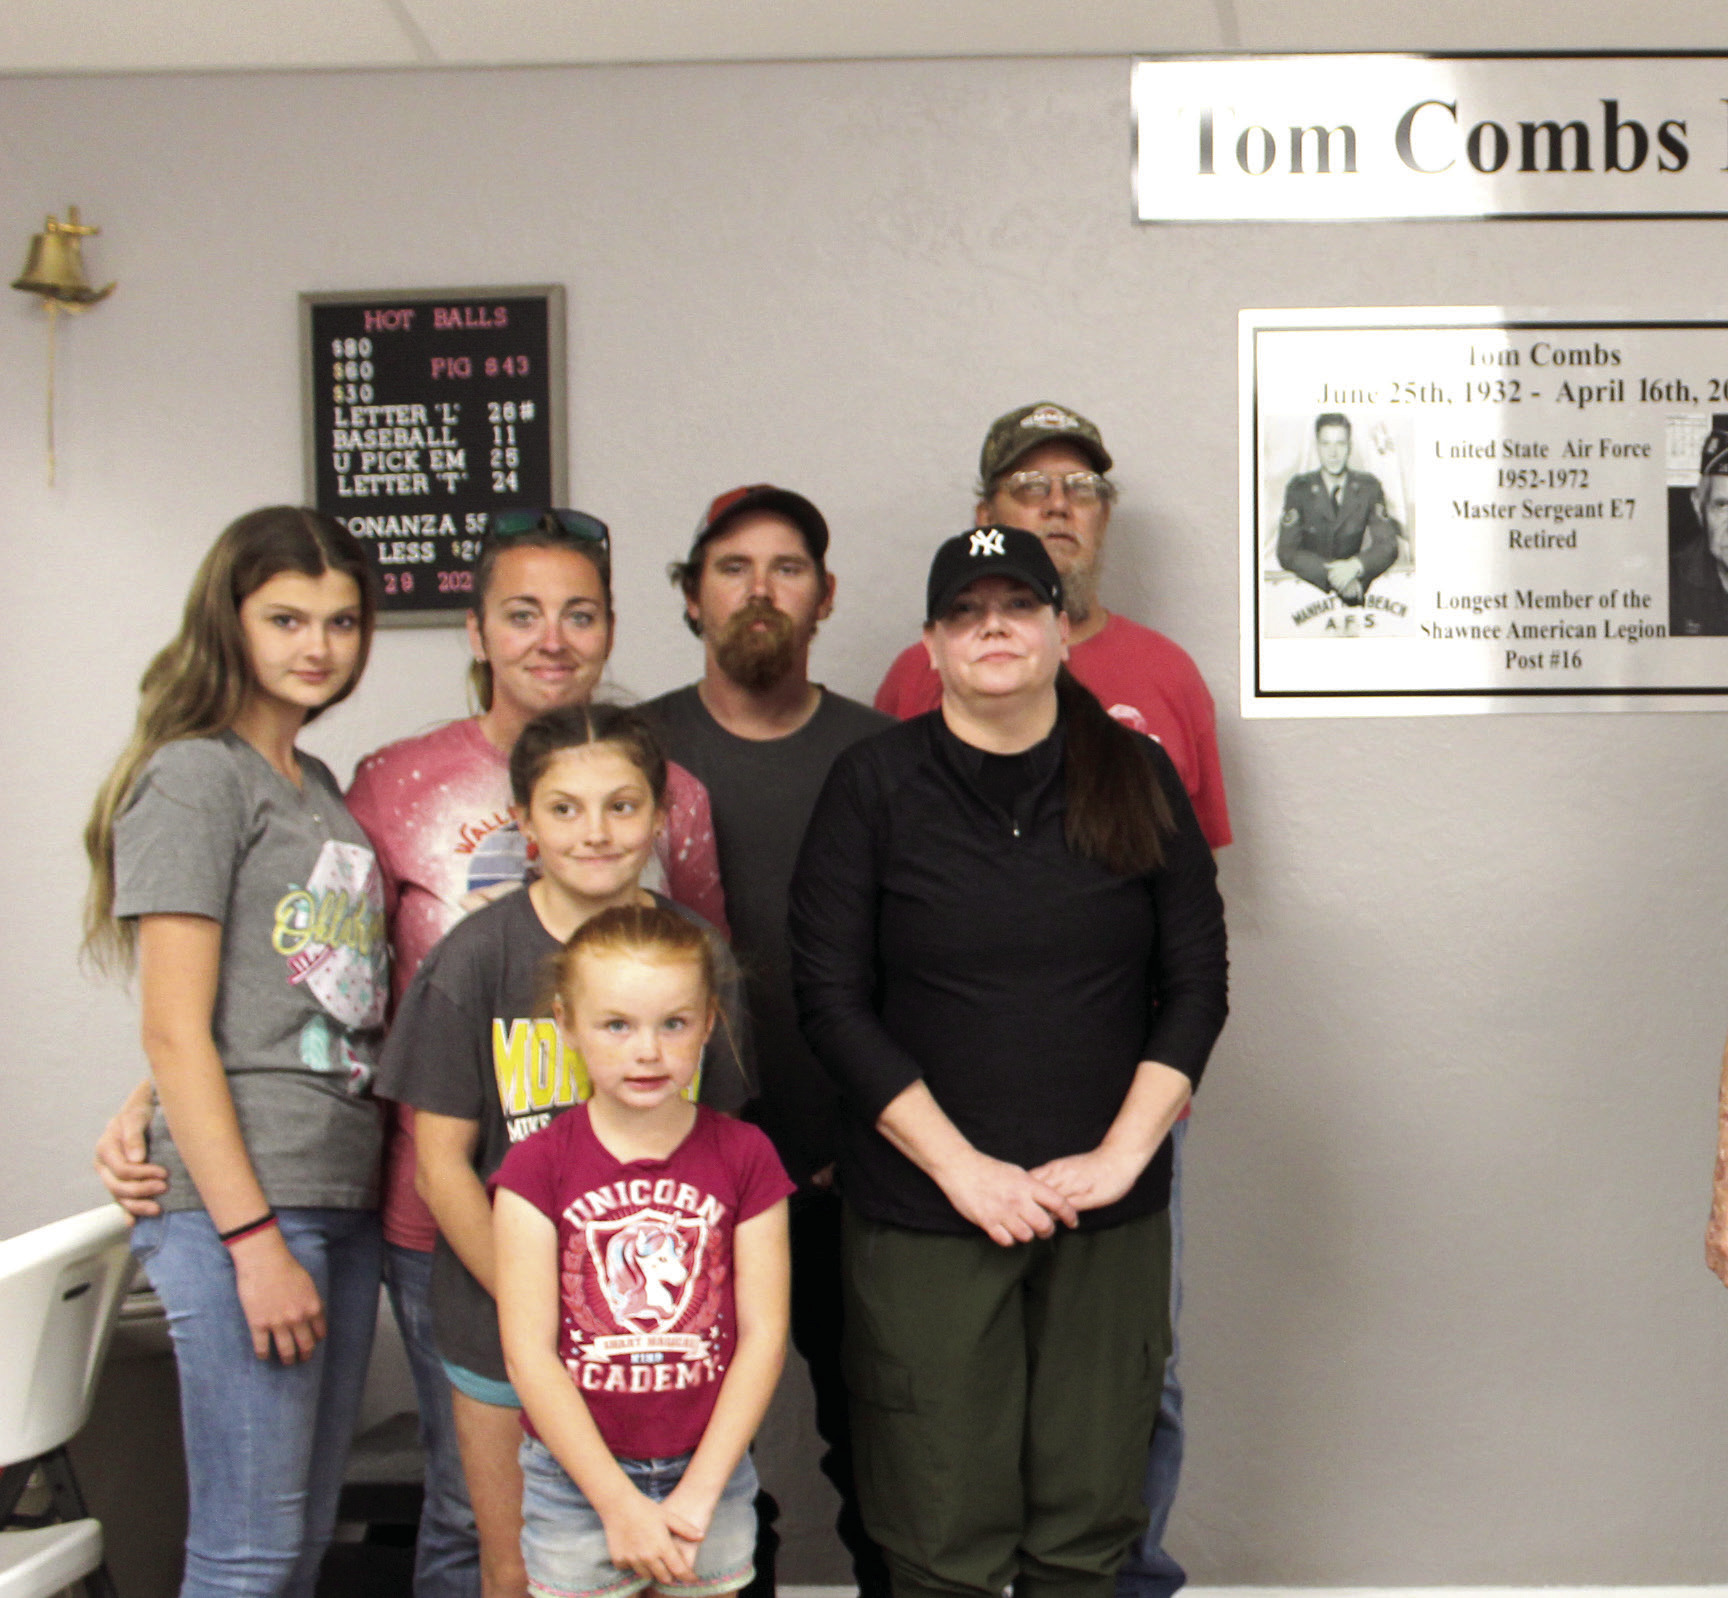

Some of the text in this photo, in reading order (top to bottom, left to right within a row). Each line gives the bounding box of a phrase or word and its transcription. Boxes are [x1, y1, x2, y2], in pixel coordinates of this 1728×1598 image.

[1181, 105, 1359, 175] Tom
[1394, 98, 1690, 175] Combs
[364, 306, 509, 332] HOT BALLS
[332, 337, 373, 359] $80
[1467, 342, 1622, 367] Tom Combs
[333, 383, 374, 404] $30
[1317, 383, 1379, 404] June
[1390, 381, 1452, 405] 25th,
[1465, 379, 1522, 403] 1932
[1556, 378, 1625, 409] April
[1639, 377, 1699, 406] 16th,
[334, 404, 428, 428] LETTER
[333, 426, 458, 450] BASEBALL
[1435, 438, 1651, 459] United State Air Force
[333, 453, 350, 473] U
[361, 450, 420, 473] PICK
[430, 448, 466, 470] EM
[338, 473, 429, 497] LETTER
[492, 471, 519, 493] 24
[1498, 468, 1590, 489] 1952-1972
[1452, 498, 1637, 523] Master Sergeant E7
[335, 513, 457, 538] ONANZA
[1508, 528, 1577, 549] Retired
[377, 541, 436, 564] LESS
[437, 571, 475, 593] 202
[1436, 589, 1652, 613] Longest Member of the
[1420, 619, 1667, 643] Shawnee American Legion
[1505, 650, 1583, 669] Post #16
[562, 1178, 727, 1231] UNICORN
